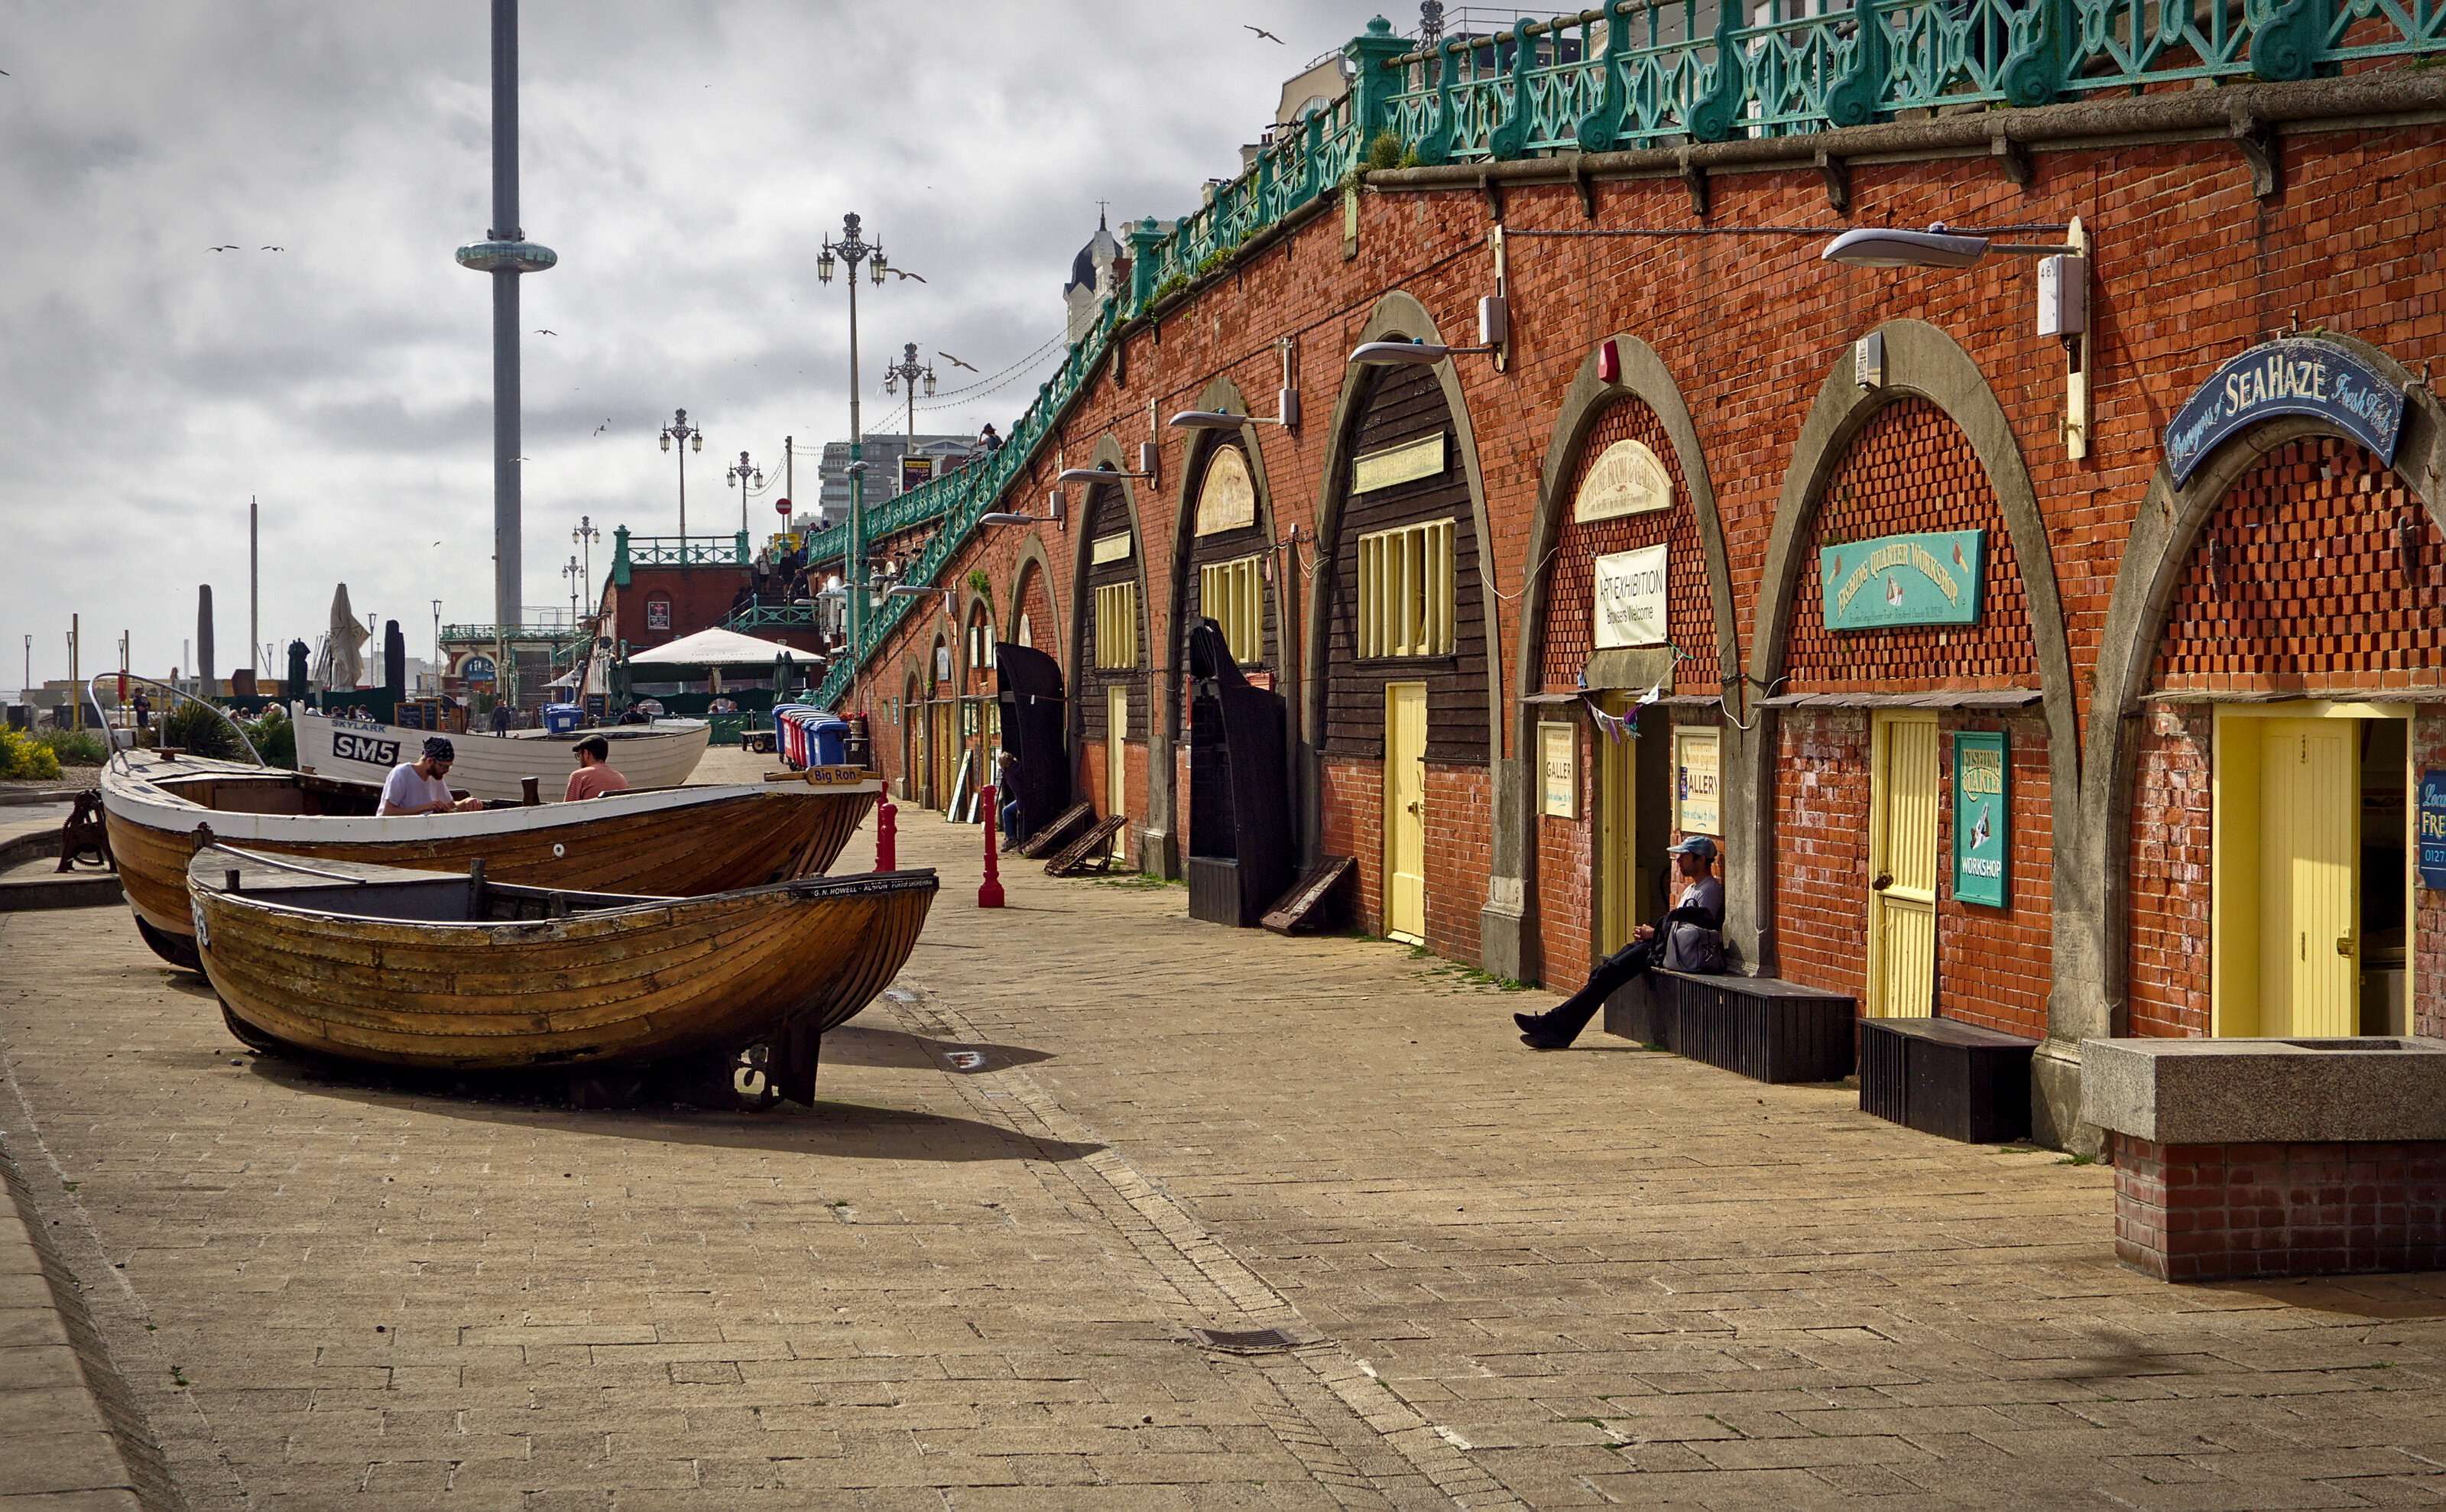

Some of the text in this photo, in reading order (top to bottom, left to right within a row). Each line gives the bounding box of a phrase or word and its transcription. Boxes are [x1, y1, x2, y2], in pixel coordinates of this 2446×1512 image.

[2041, 266, 2051, 280] 46
[2331, 373, 2368, 417] Fresh
[1607, 456, 1627, 488] ROOM
[1628, 457, 1635, 483] &
[1600, 569, 1663, 602] ART EXHIBITION
[1837, 542, 1958, 622] FISHING QUARTER WORKSHOP
[1607, 604, 1653, 625] Browsers Welcome
[332, 719, 386, 734] SKYLARK
[336, 735, 395, 764] SM5
[1546, 761, 1572, 779] GALLER
[1963, 748, 2001, 777] FISHING
[815, 769, 856, 783] Big Ron
[1963, 768, 2001, 802] QUARTER
[2422, 811, 2446, 840] FRE
[1961, 857, 2001, 878] WORKSHOP
[2425, 849, 2446, 862] 0127
[830, 885, 857, 895] HOWELL
[864, 881, 887, 891] ALBION
